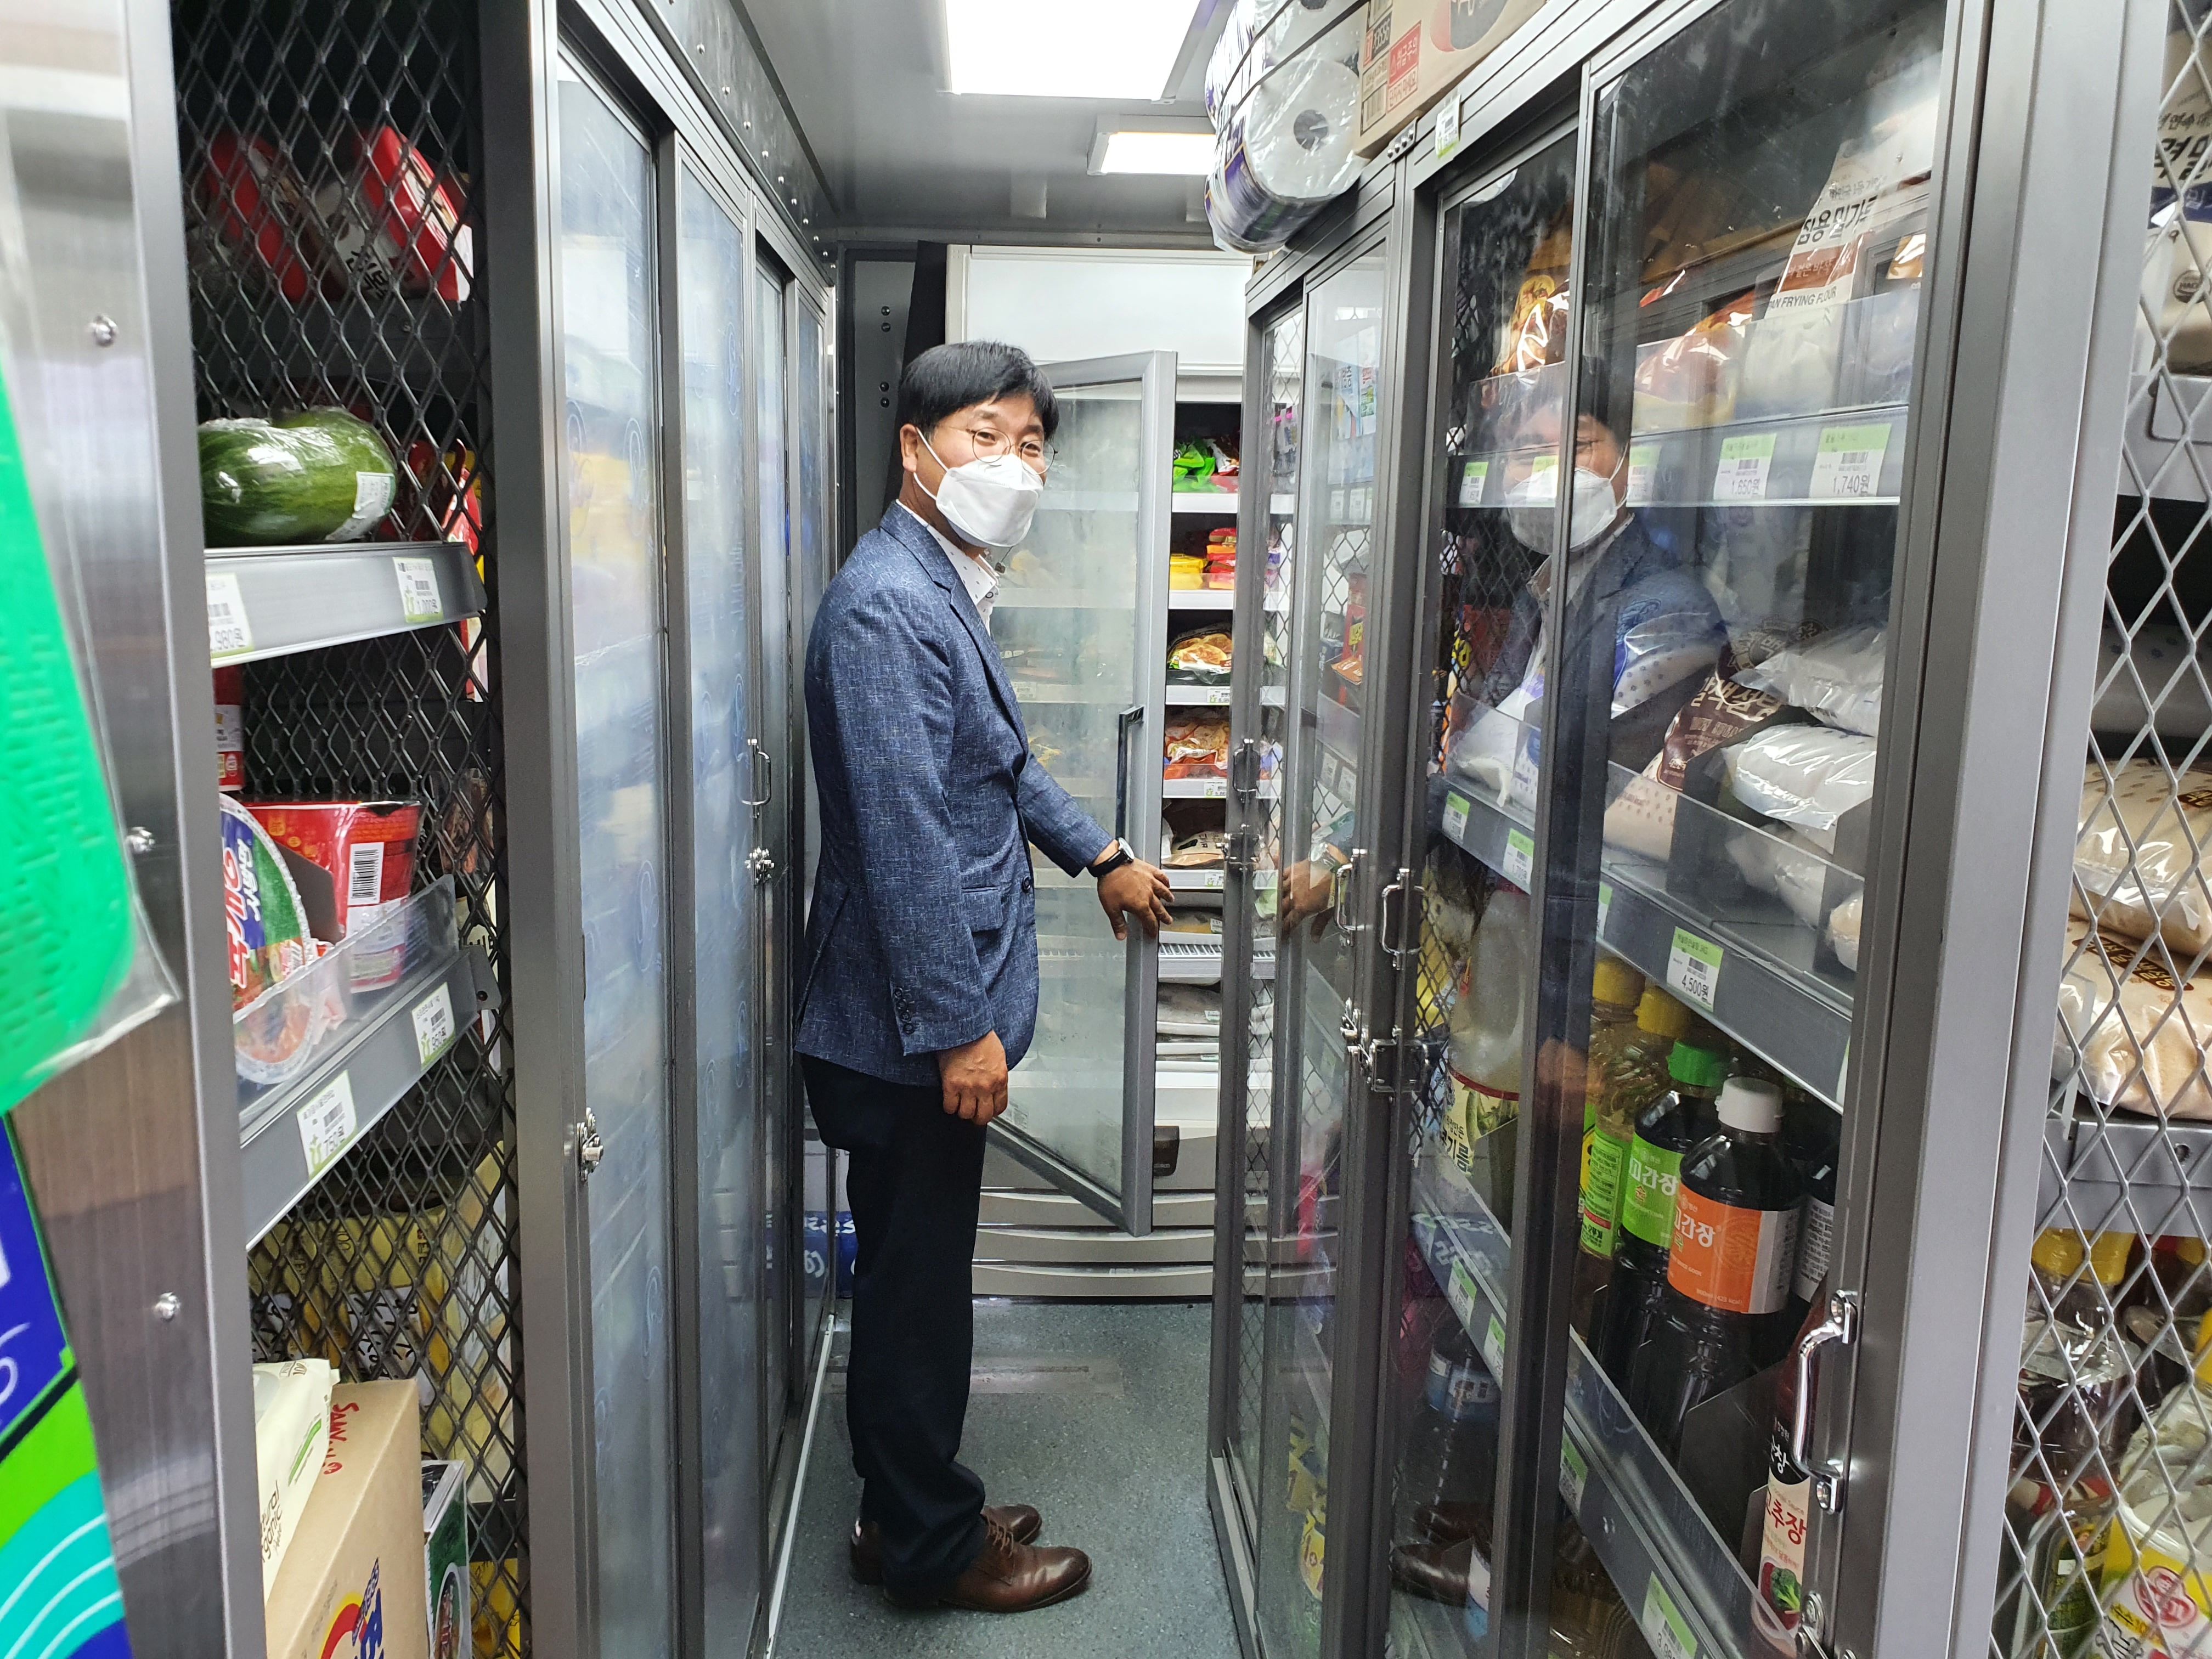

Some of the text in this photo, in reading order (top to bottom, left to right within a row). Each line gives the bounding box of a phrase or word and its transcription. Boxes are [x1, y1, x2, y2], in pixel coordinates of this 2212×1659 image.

[1782, 293, 1816, 307] FRYING
[1816, 286, 1837, 304] FLOUR
[1833, 473, 1871, 494] 1,740원
[1681, 974, 1709, 1003] 4,500원
